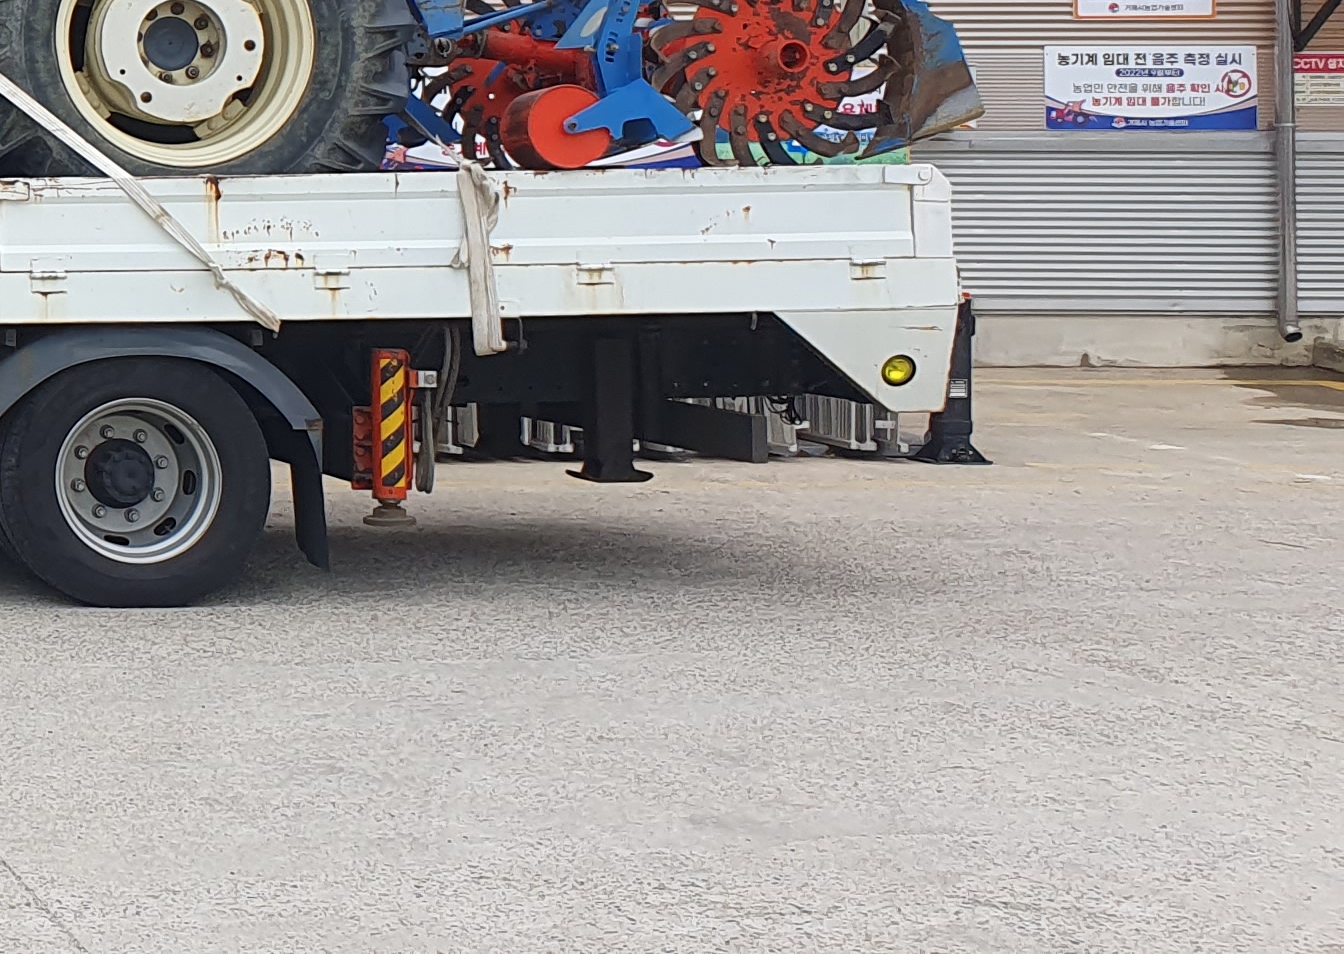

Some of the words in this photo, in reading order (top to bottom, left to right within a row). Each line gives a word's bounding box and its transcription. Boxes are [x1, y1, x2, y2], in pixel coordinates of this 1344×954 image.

[1057, 53, 1098, 66] 농기계
[1102, 53, 1130, 66] 임대
[1134, 53, 1148, 66] 전
[1151, 53, 1179, 66] 음주
[1183, 53, 1211, 66] 측정
[1215, 53, 1243, 66] 실시
[1072, 82, 1104, 94] 농업인
[1092, 96, 1123, 107] 농기계
